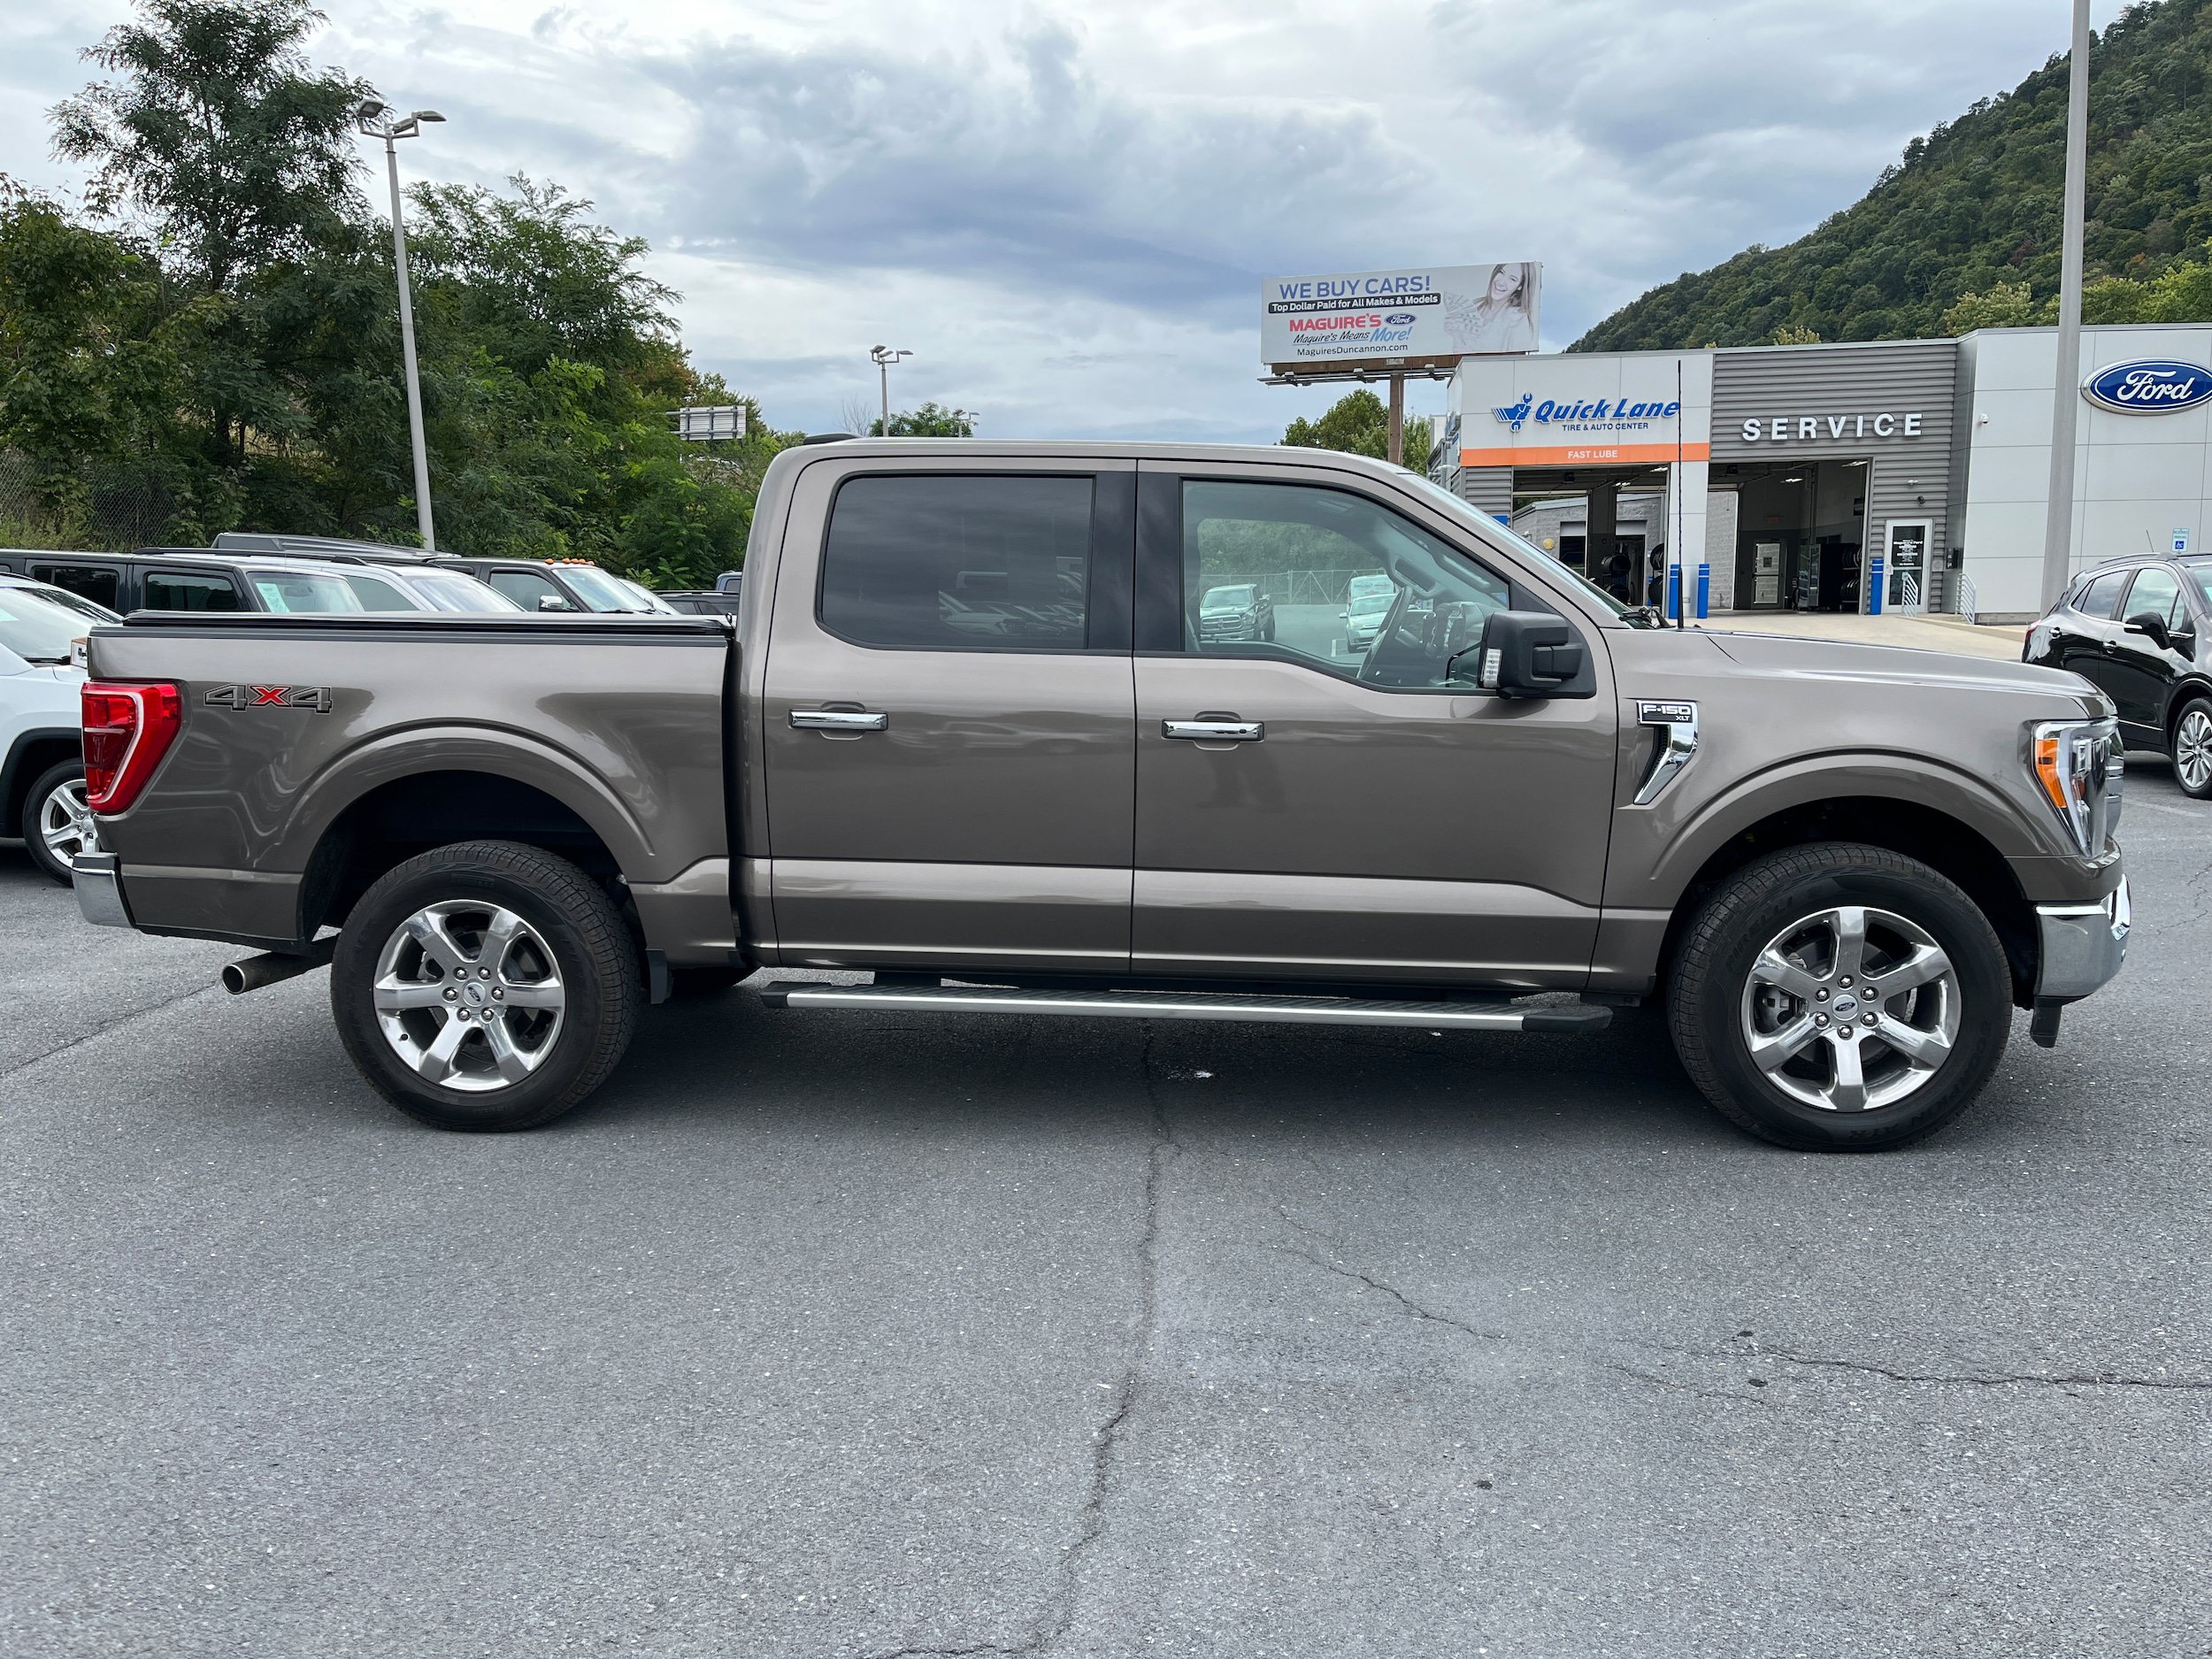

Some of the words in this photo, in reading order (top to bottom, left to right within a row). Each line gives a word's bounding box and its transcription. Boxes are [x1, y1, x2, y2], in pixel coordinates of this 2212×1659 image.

[1279, 282, 1311, 299] WE
[1317, 280, 1361, 297] BUY
[1364, 275, 1431, 295] CARS!
[1271, 303, 1288, 312] Top
[1289, 302, 1316, 311] Dollar
[1317, 300, 1336, 309] Paid
[1337, 299, 1350, 308] for
[1351, 298, 1364, 307] All
[1365, 297, 1394, 307] Makes
[1395, 296, 1403, 305] &
[1404, 295, 1438, 304] Models
[1289, 313, 1381, 332] MAGUIRE'S
[1390, 314, 1411, 324] Ford
[1293, 333, 1338, 345] Maguire's
[1340, 331, 1371, 341] Means
[1370, 326, 1412, 342] More!
[1297, 343, 1408, 357] MaguiresDuncannon.com
[2116, 369, 2196, 401] Ford
[1534, 398, 1612, 423] Quick
[1612, 397, 1679, 419] Lane
[1583, 423, 1589, 432] &
[1615, 422, 1648, 431] CENTER
[1742, 413, 1923, 442] SERVICE
[1568, 449, 1591, 459] FAST
[1594, 449, 1618, 458] LUBE
[1642, 704, 1692, 715] F-150
